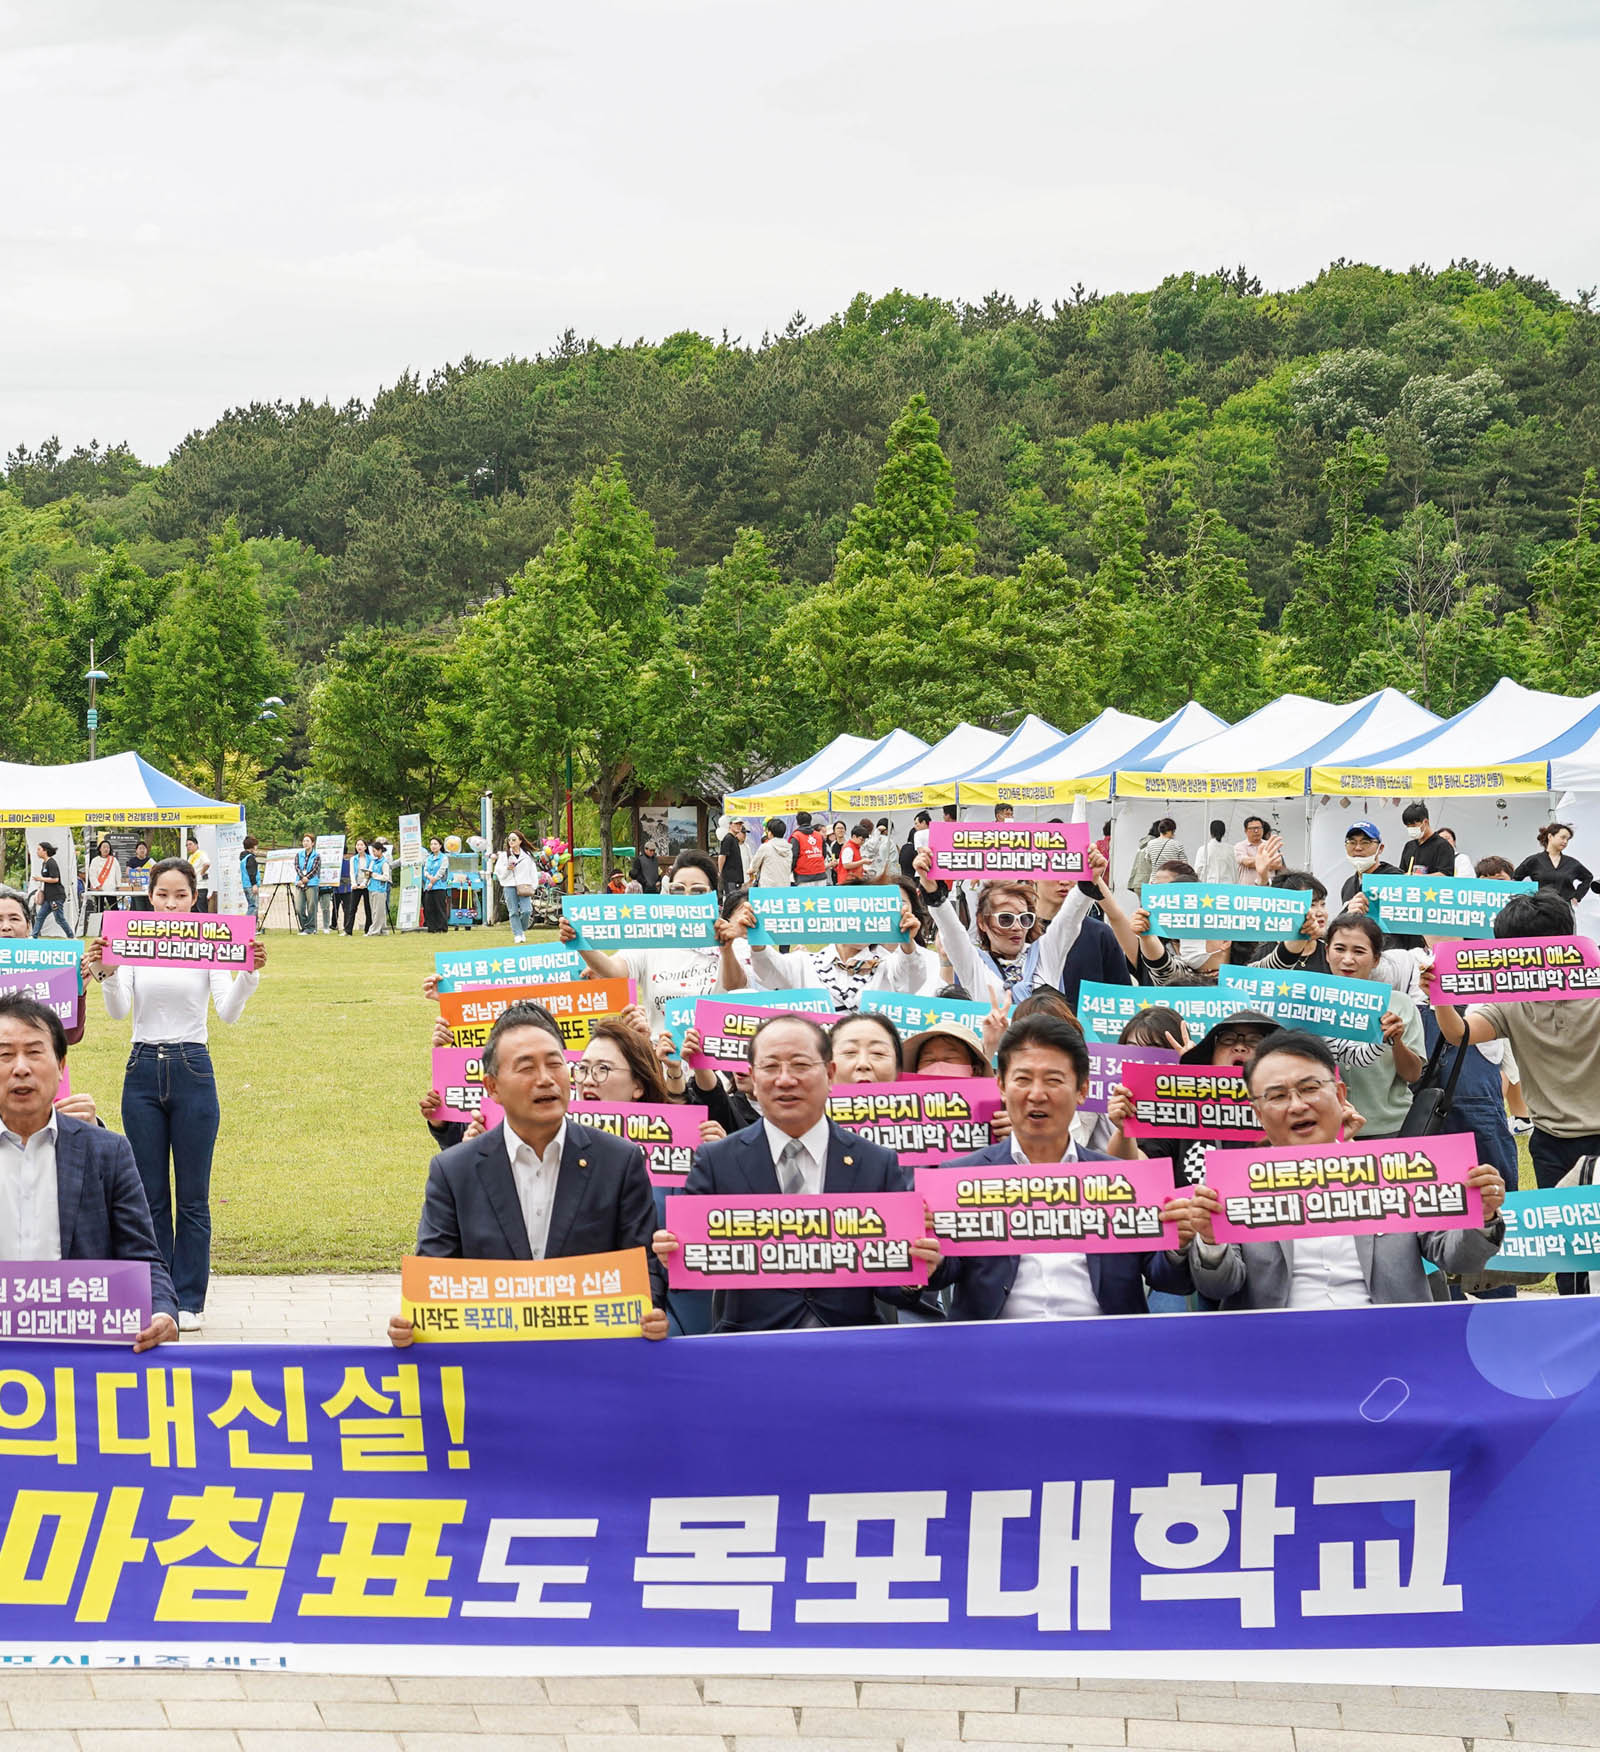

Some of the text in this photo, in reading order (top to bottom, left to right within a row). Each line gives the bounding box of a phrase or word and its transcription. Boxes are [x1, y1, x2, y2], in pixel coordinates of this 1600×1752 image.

[85, 813, 111, 823] 대한민국
[113, 813, 125, 822] 아동
[161, 812, 180, 822] 보고서
[953, 831, 1066, 850] 의료취약지 해소
[937, 852, 1083, 870] 목포대 의과대학 신설
[569, 903, 715, 921] 34년 이루어진다
[753, 897, 900, 914] 34년 이루어진다
[1148, 895, 1304, 913] 34년 이루어진다
[1379, 906, 1485, 926] 목포대 의과대학
[127, 920, 231, 940] 의료취약지 해소
[581, 923, 706, 940] 목포대 의과대학 신설
[764, 917, 891, 934] 목포대 의과대학 신설
[1158, 915, 1293, 932] 목포대 의과대학 신설
[112, 940, 246, 962] 목포대 의과대학 신설
[1456, 946, 1583, 968] 의료취약지 해소
[1441, 967, 1600, 992] 목포대 의과대학 신설
[1310, 986, 1383, 1011] 이루어진다
[1278, 1004, 1369, 1030] 의과대학 신설
[924, 1094, 969, 1118] 해소
[863, 1124, 991, 1149] 의과대학 신설
[1249, 1151, 1434, 1190] 의료취약지 해소
[957, 1176, 1134, 1206] 의료취약지 해소
[1226, 1183, 1465, 1228] 목포대 의과대학 신설
[708, 1207, 884, 1238] 의료취약지 해소
[933, 1205, 1161, 1240] 목포대 의과대학 신설
[684, 1239, 911, 1271] 목포대 의과대학 신설
[13, 1278, 61, 1303] 34년
[67, 1277, 109, 1302] 숙원
[429, 1269, 621, 1298] 전남권 의과대학 신설
[16, 1310, 97, 1335] 의과대학
[102, 1308, 141, 1334] 신설
[411, 1300, 642, 1333] 시작도 목포대, 마침표도 목포대
[633, 1470, 1464, 1632] 목포대학교
